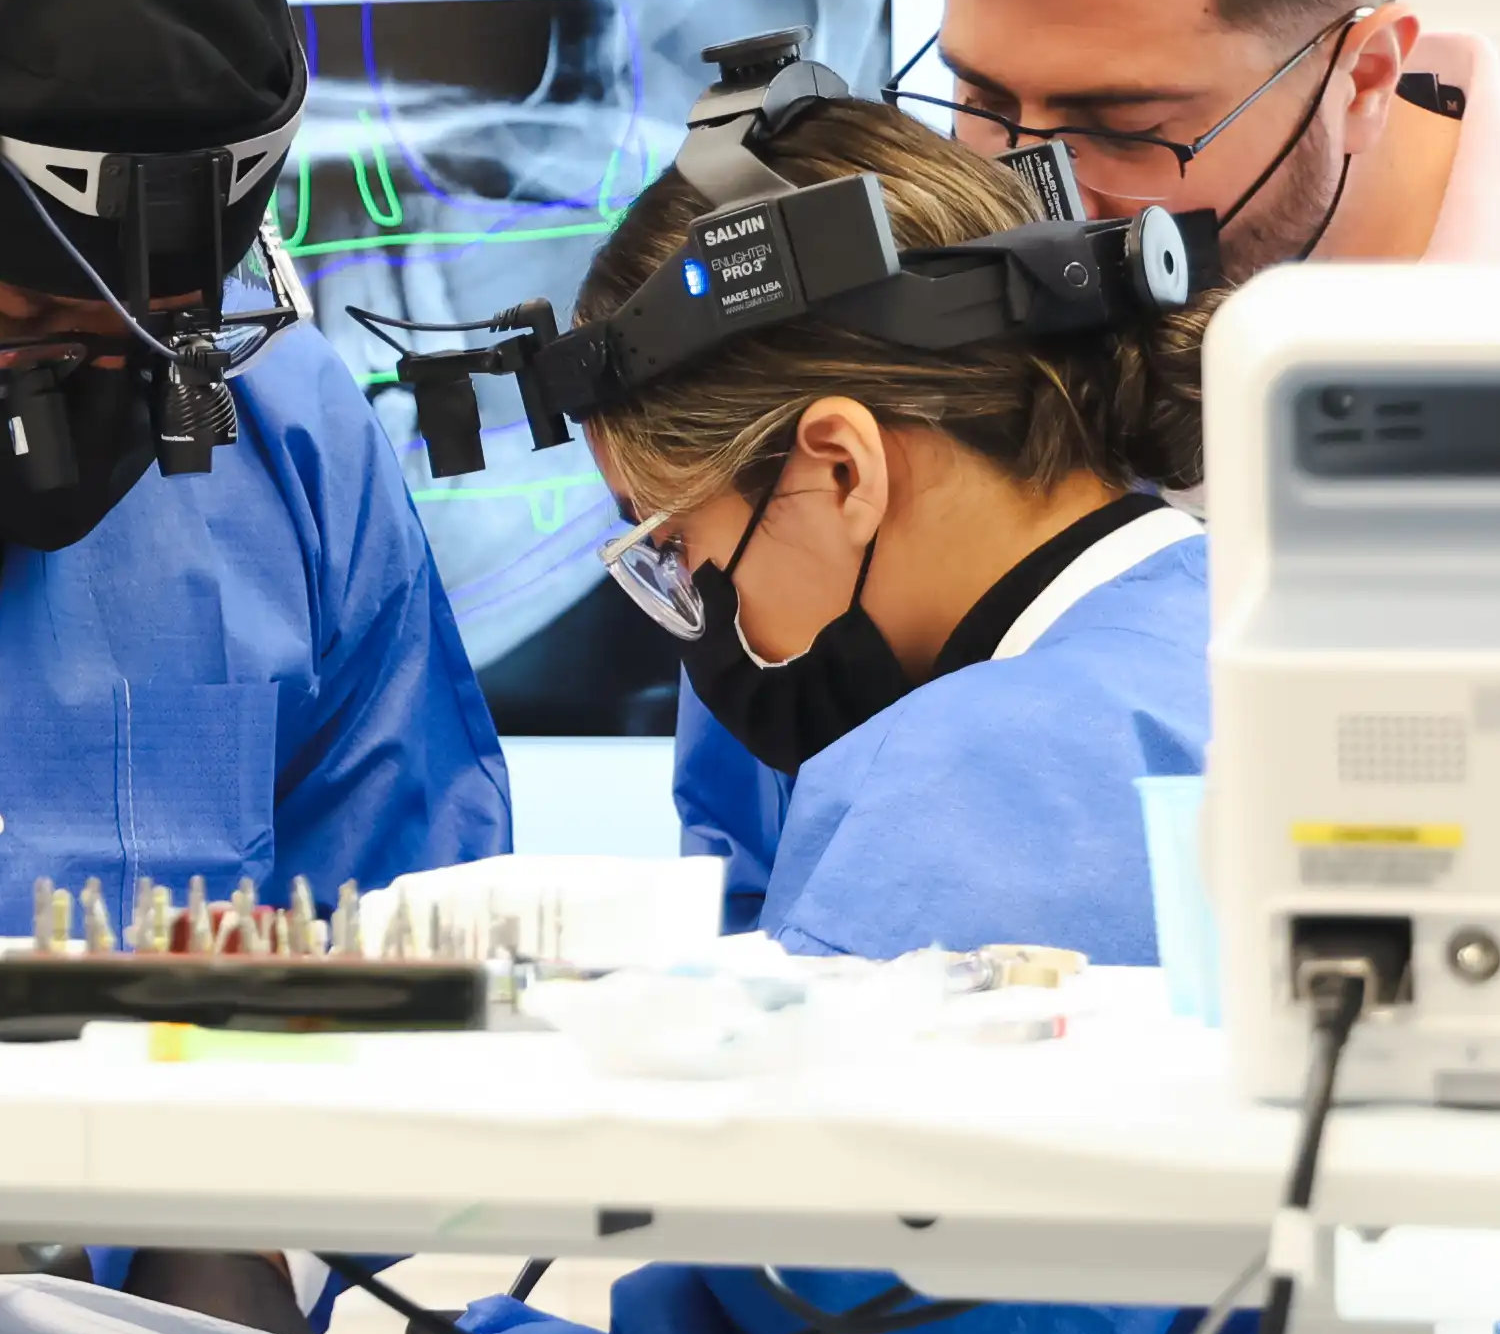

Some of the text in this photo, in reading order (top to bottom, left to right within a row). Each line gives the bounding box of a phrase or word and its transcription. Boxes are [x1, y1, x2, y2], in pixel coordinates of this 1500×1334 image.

[704, 215, 765, 246] SALVIN
[711, 243, 772, 271] ENLIGHTEN
[722, 261, 753, 282] PRO
[721, 280, 782, 306] MADE IN USA
[724, 291, 785, 315] www.salvin.com
